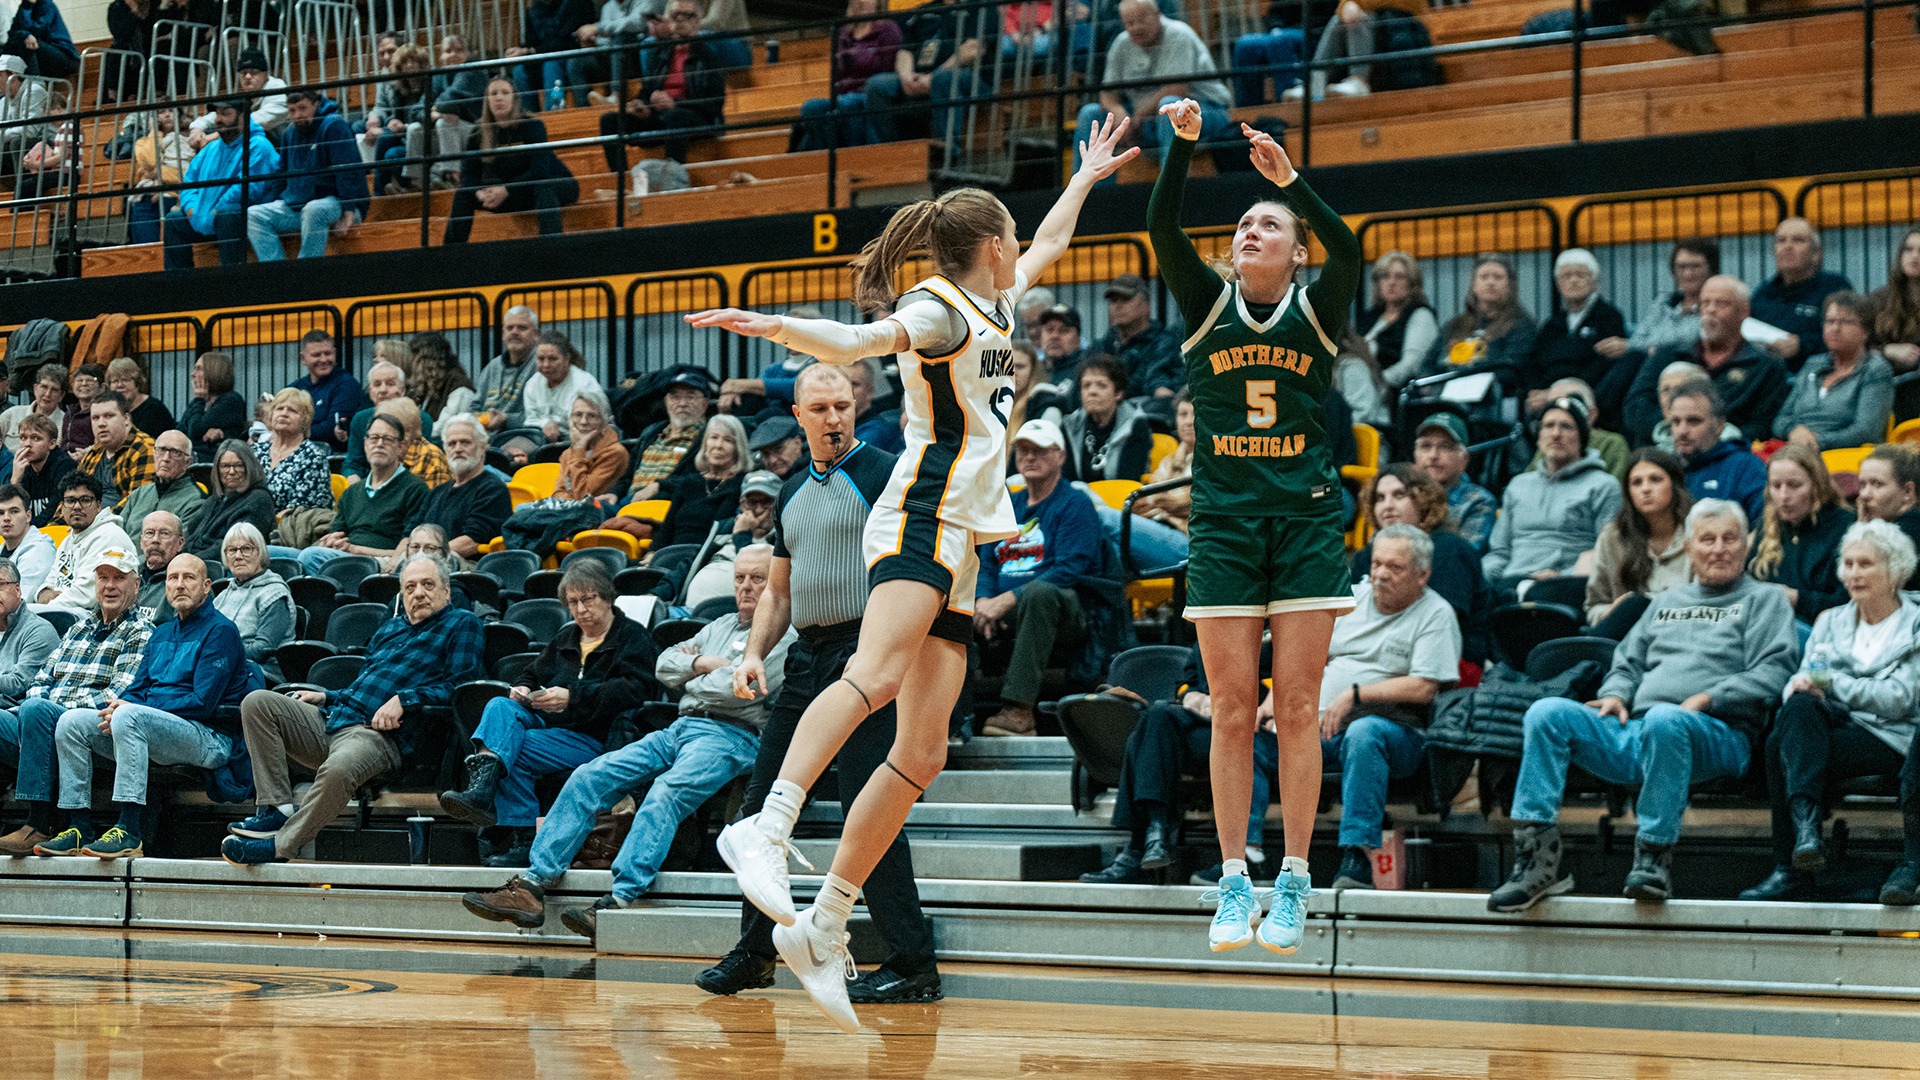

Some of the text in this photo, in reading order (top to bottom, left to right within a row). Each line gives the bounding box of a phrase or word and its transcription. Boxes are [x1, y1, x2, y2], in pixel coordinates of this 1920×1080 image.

[813, 213, 838, 252] B
[1209, 344, 1313, 376] NORTHERN
[1245, 379, 1277, 429] 5
[1212, 434, 1305, 457] MICHIGAN
